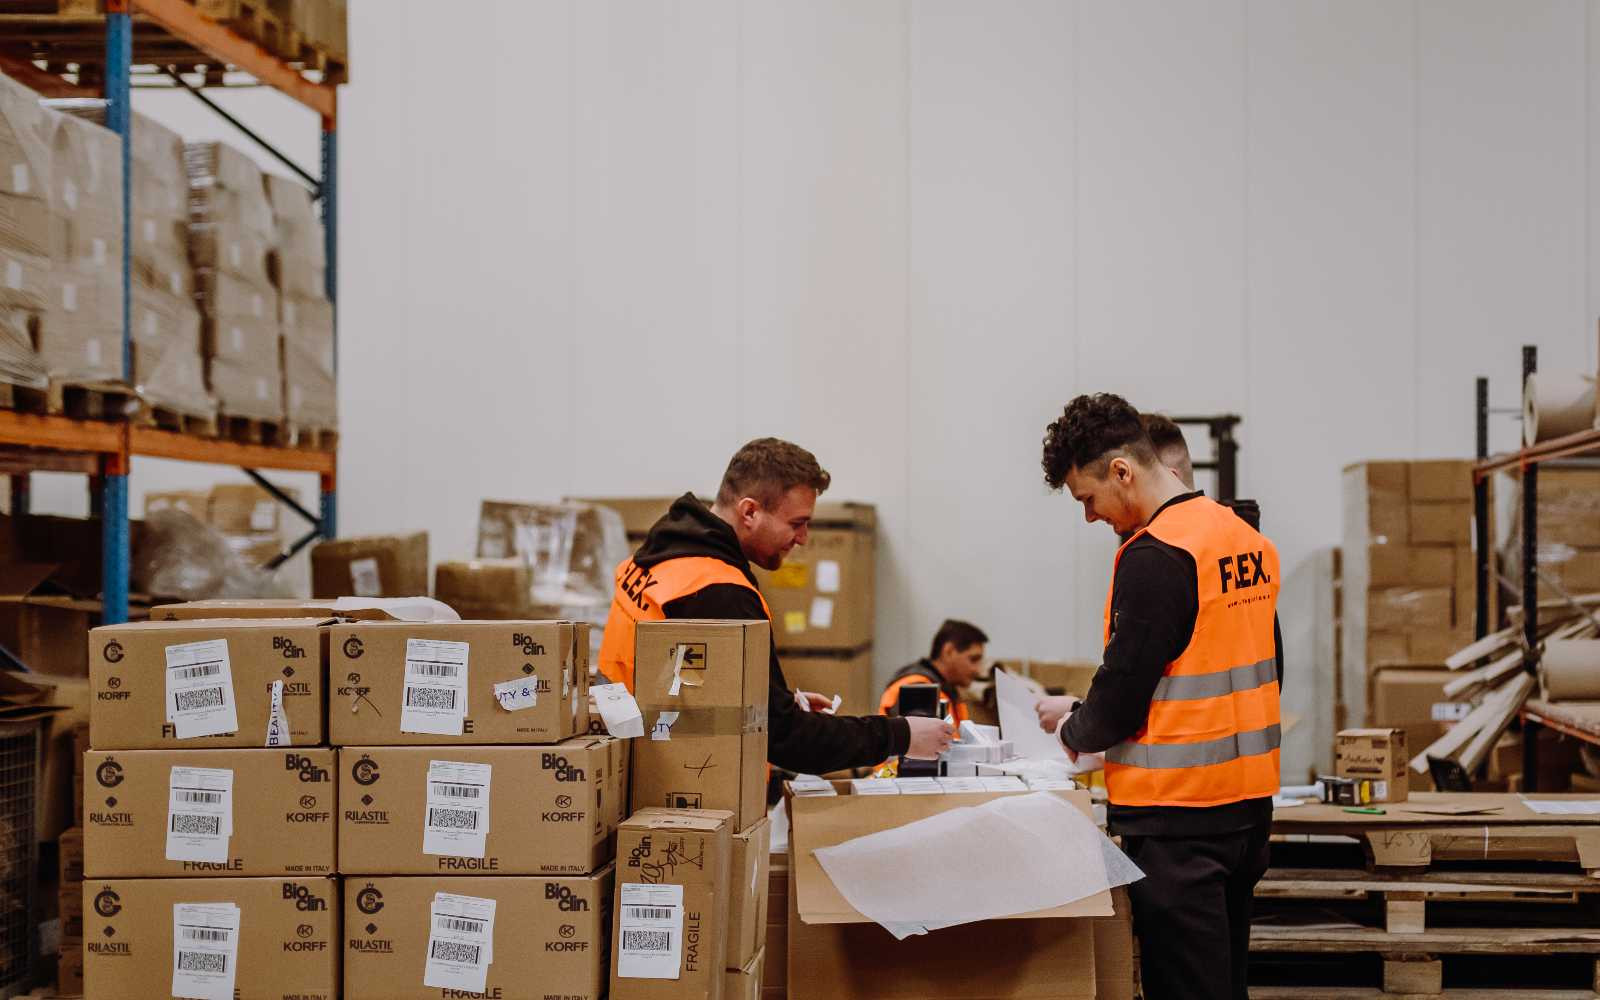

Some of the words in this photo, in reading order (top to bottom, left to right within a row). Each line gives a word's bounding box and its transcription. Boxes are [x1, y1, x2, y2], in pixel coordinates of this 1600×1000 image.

[1218, 551, 1271, 594] FLEX.
[273, 636, 292, 650] Bio
[512, 633, 533, 646] Bio
[97, 691, 131, 700] KORFF
[285, 754, 312, 770] Bio
[541, 753, 568, 770] Bio
[89, 812, 133, 823] RILASTIL
[286, 812, 330, 823] KORFF
[345, 810, 389, 820] RILASTIL
[541, 811, 586, 822] KORFF
[438, 857, 499, 870] FRAGILE
[628, 847, 641, 867] Bio
[282, 882, 308, 899] Bio
[545, 882, 571, 899] Bio
[88, 942, 131, 952] RILASTIL
[283, 941, 328, 952] KORFF
[350, 939, 392, 950] RILASTIL
[545, 941, 589, 952] KORFF
[686, 912, 701, 971] FRAGILE
